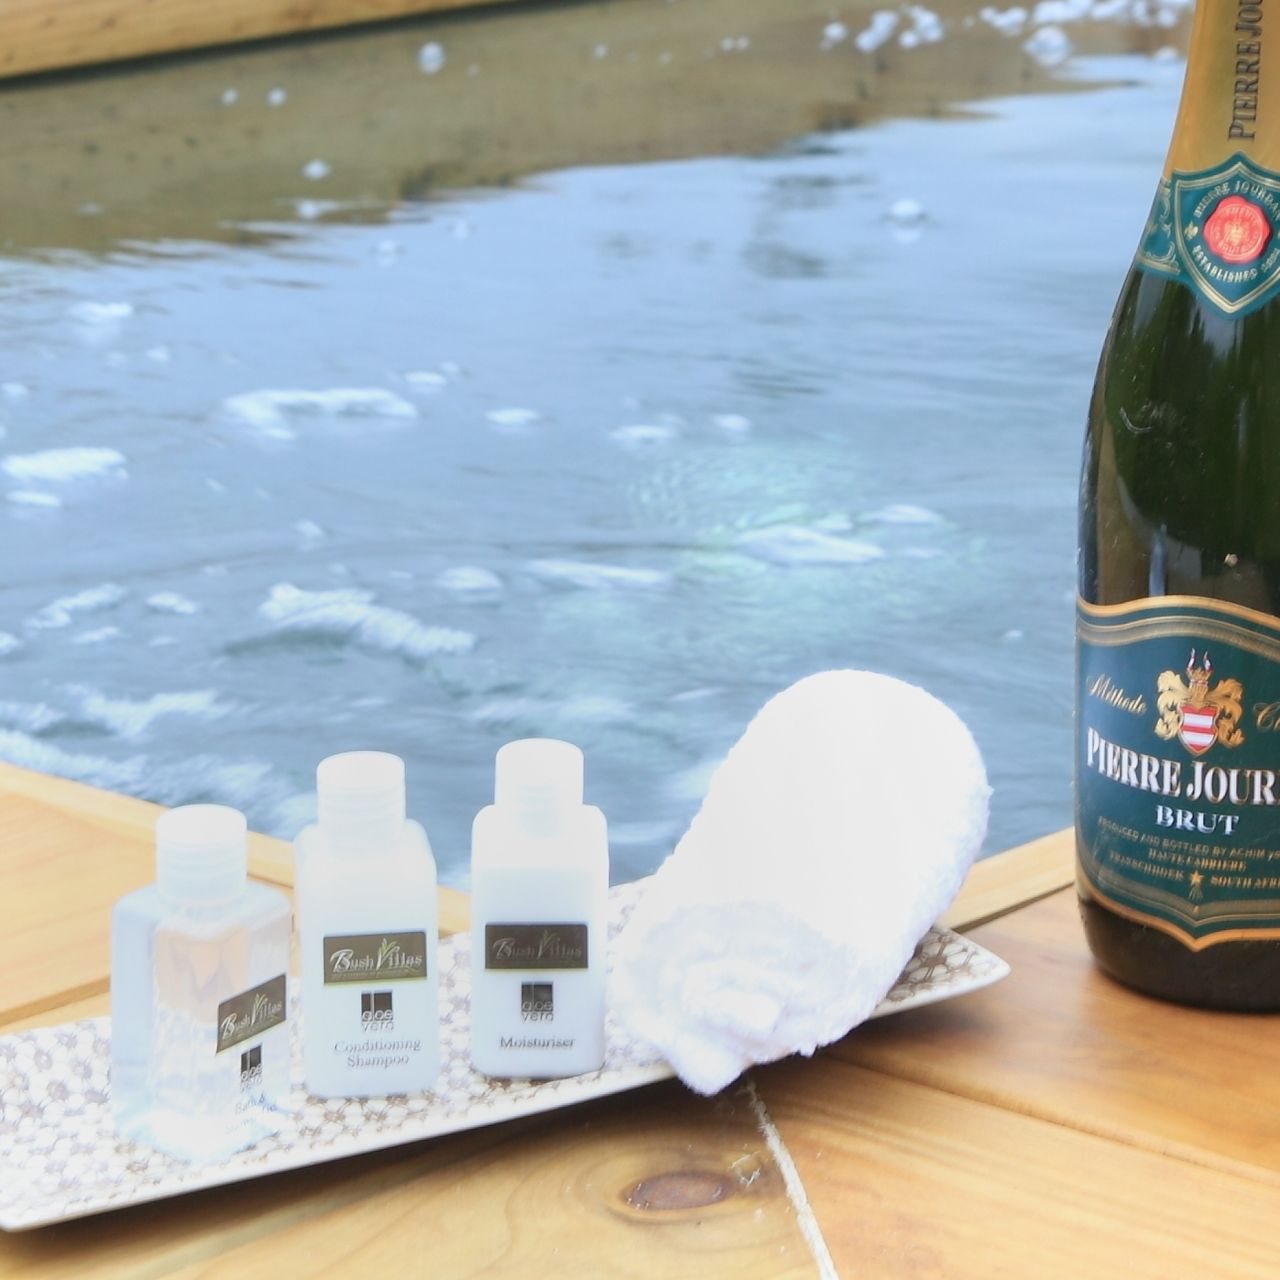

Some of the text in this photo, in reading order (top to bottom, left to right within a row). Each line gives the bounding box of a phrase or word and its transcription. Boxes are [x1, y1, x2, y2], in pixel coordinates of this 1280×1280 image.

[1228, 41, 1261, 142] PIERRE
[1086, 726, 1182, 798] PIERRE
[1154, 804, 1239, 836] BRUT
[1162, 838, 1209, 857] BOTTLED
[1211, 845, 1227, 857] BY
[330, 937, 423, 973] Bush Villas
[333, 1038, 422, 1054] Conditioning
[500, 1035, 576, 1049] Moisturiser
[347, 1054, 410, 1069] Shampoo
